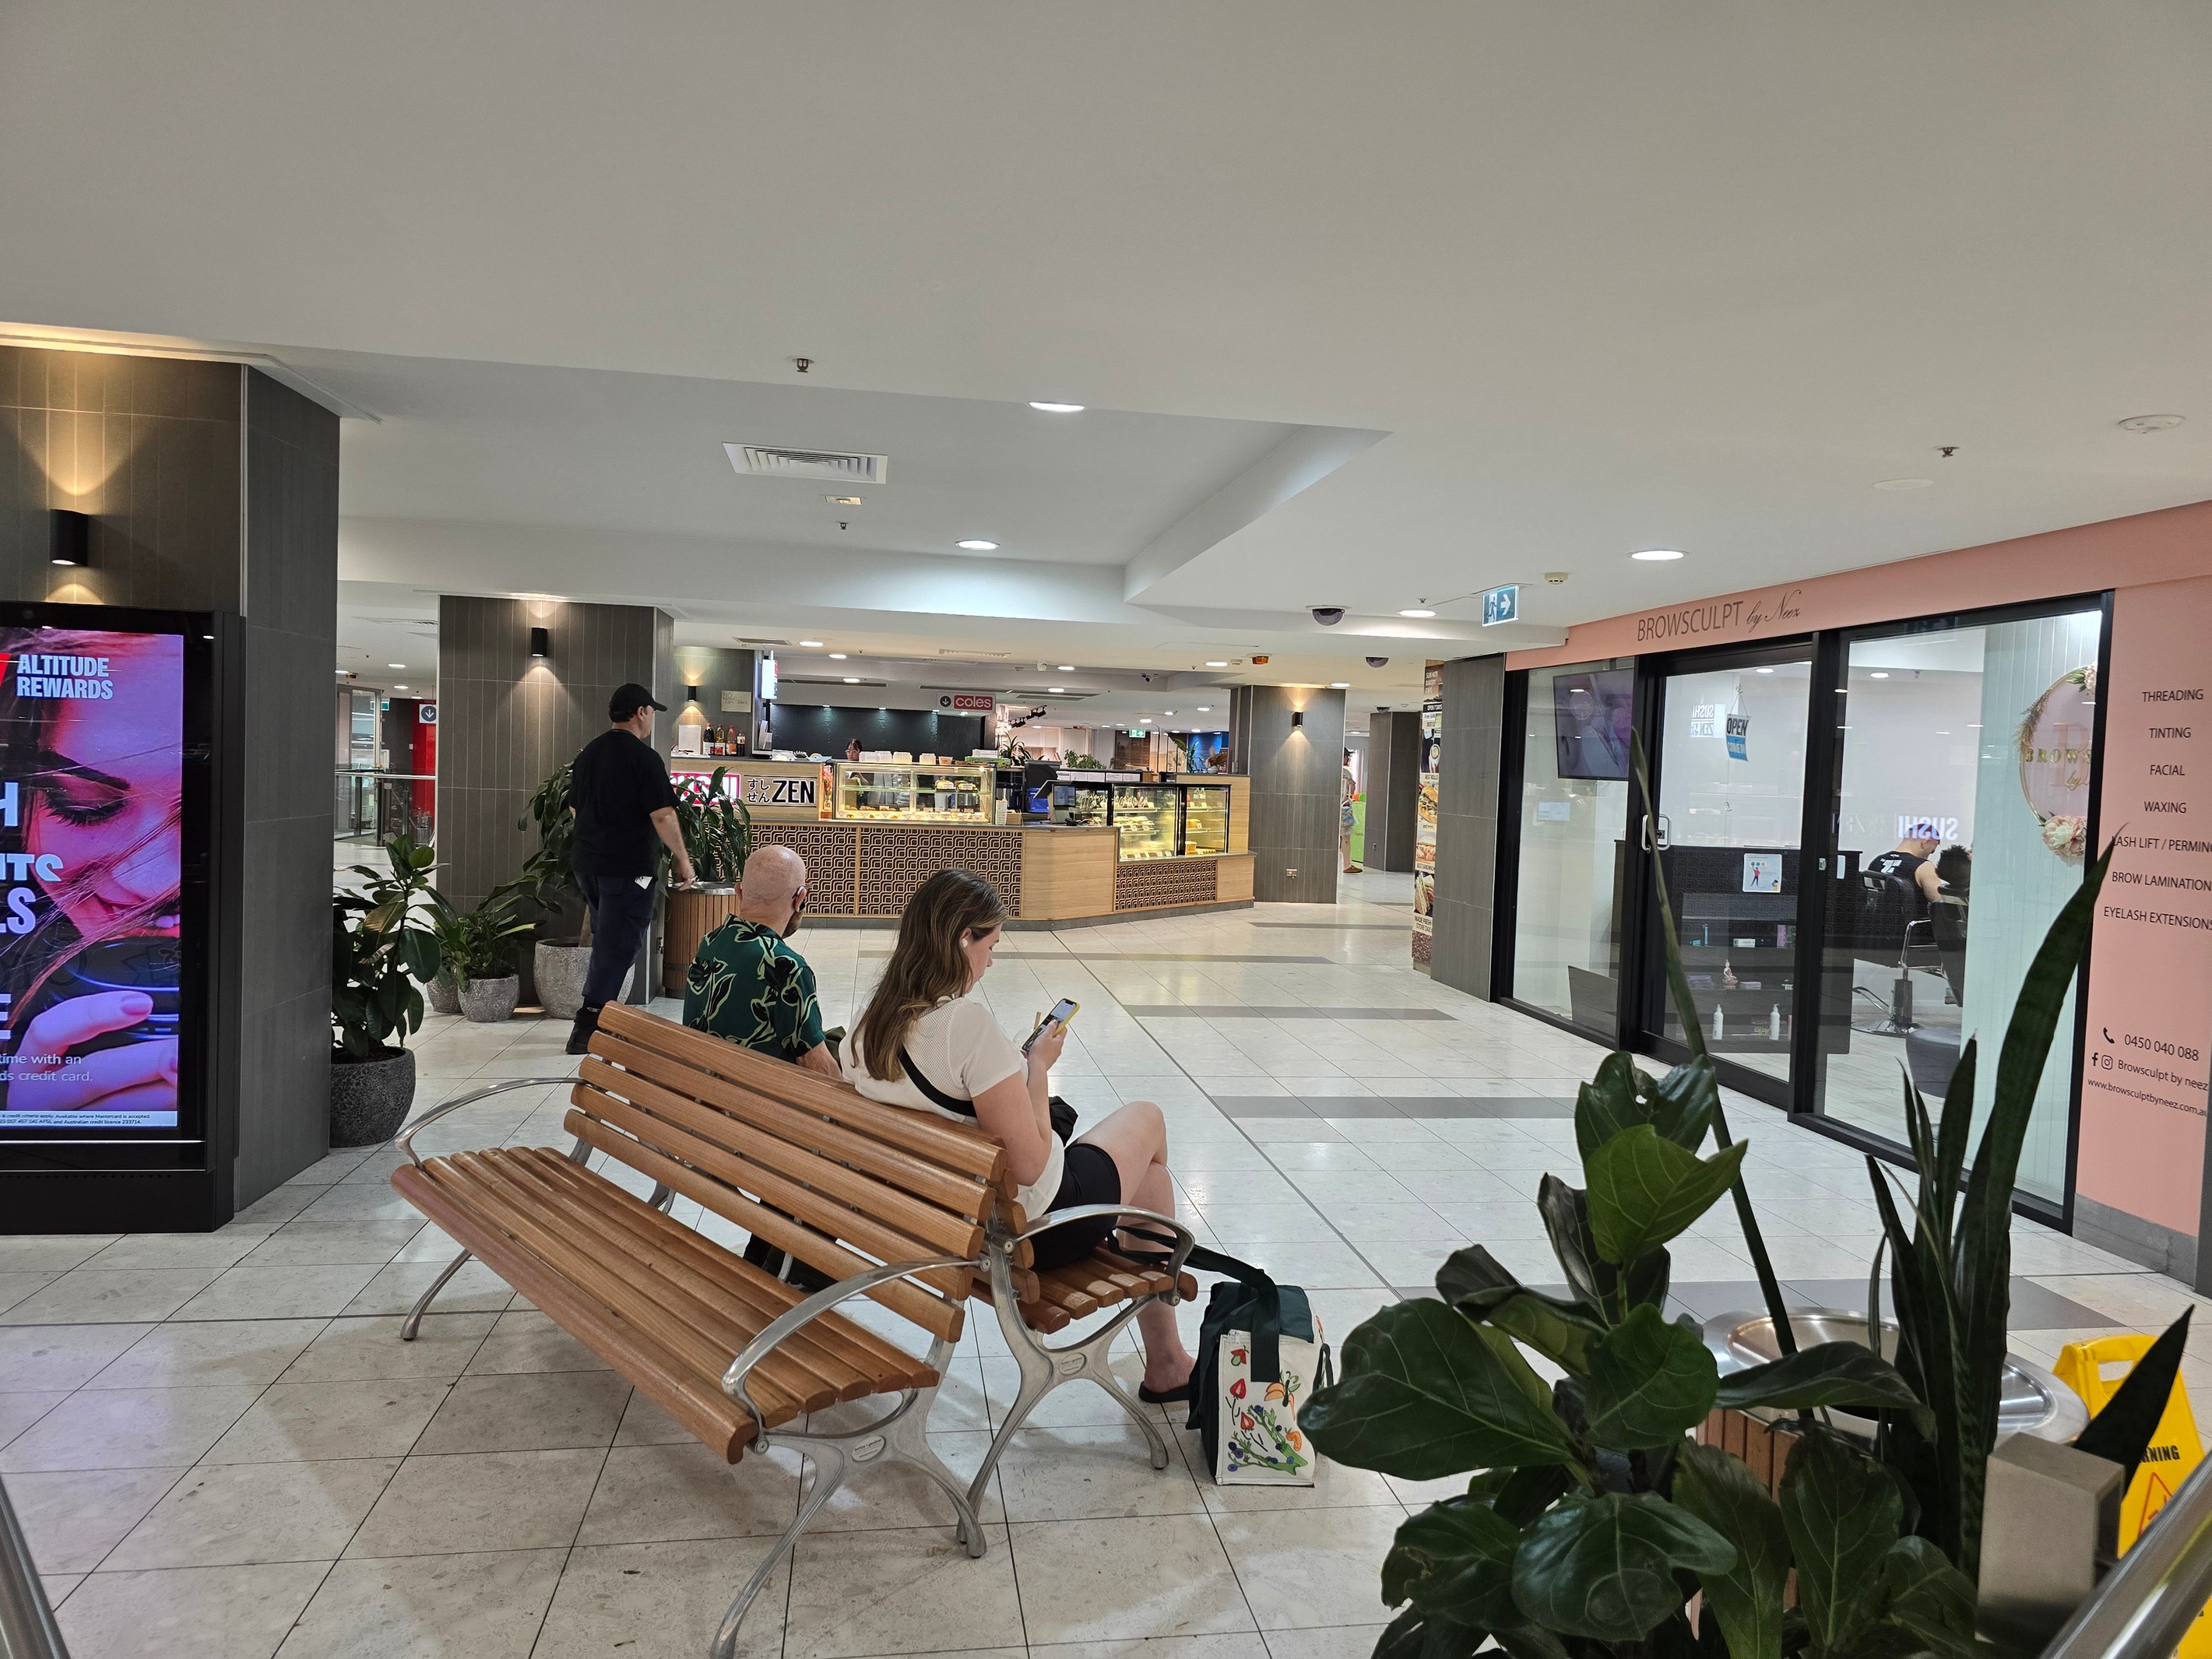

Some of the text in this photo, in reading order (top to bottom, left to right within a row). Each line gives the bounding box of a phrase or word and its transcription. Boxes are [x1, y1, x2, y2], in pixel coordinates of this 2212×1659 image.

[1637, 589, 1801, 641] BROWSCULPT by Neez
[16, 654, 109, 677] ALTITUDE
[16, 677, 114, 700] REWARDS
[2142, 688, 2204, 702] THREADING
[955, 696, 991, 708] coles
[1726, 717, 1749, 736] OPEN
[2149, 727, 2191, 739] TINTING
[2150, 764, 2186, 776] FACIAL
[747, 779, 769, 790] すし
[772, 780, 815, 804] ZEN
[2144, 801, 2186, 814] WAXING
[2139, 838, 2160, 849] LIFT
[2161, 838, 2167, 850] /
[2112, 871, 2212, 892] BROW LAMINATION
[0, 887, 36, 933] S
[2104, 906, 2147, 922] EYELASH
[2124, 1034, 2200, 1061] 0450 040 088
[31, 1053, 61, 1064] with
[65, 1056, 82, 1064] an
[19, 1070, 57, 1081] credit
[62, 1071, 93, 1081] card.
[2118, 1059, 2208, 1091] Browsculpt by neez
